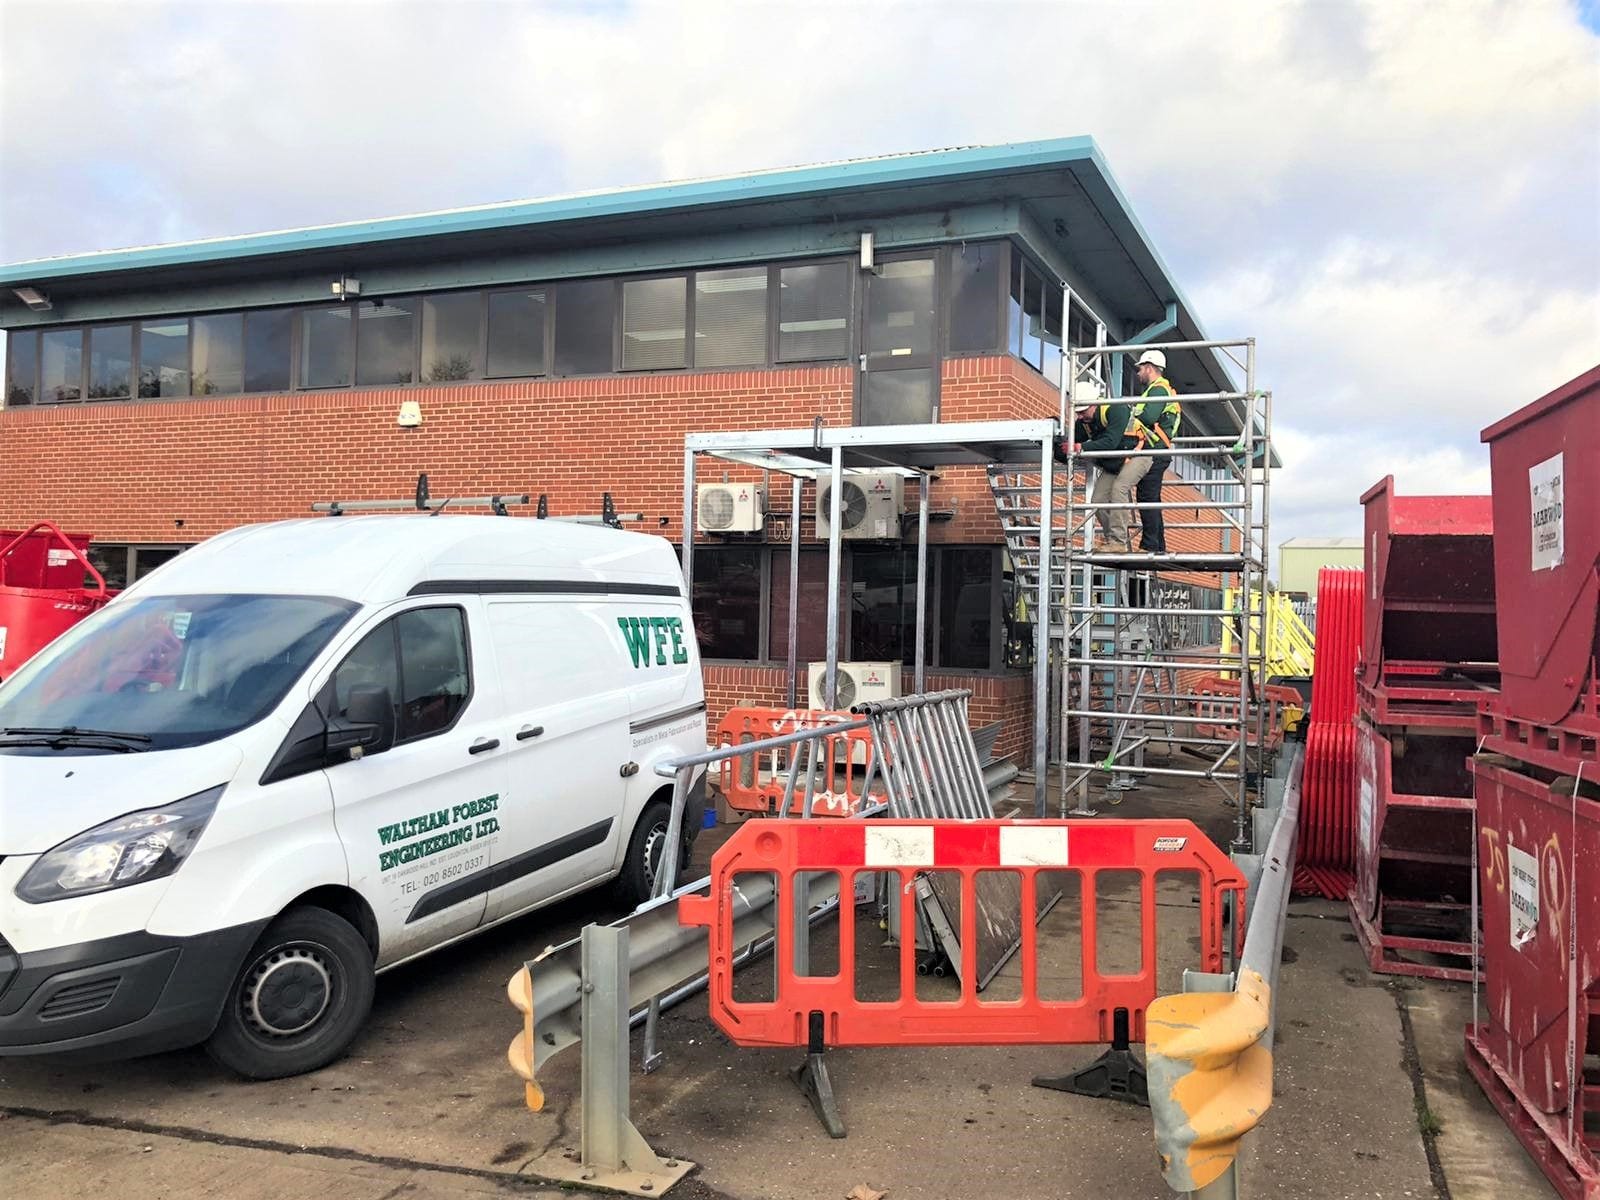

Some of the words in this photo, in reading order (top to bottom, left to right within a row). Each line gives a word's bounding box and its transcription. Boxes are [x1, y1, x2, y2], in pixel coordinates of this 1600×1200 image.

[617, 617, 688, 668] WFE
[378, 808, 449, 845] WALTHAM
[453, 793, 499, 823] FOREST
[379, 825, 473, 871] ENGINEERING
[476, 817, 500, 838] LTD.
[401, 879, 420, 895] TEL:
[424, 872, 439, 887] 020
[442, 864, 462, 879] 8502
[465, 855, 484, 870] 0337
